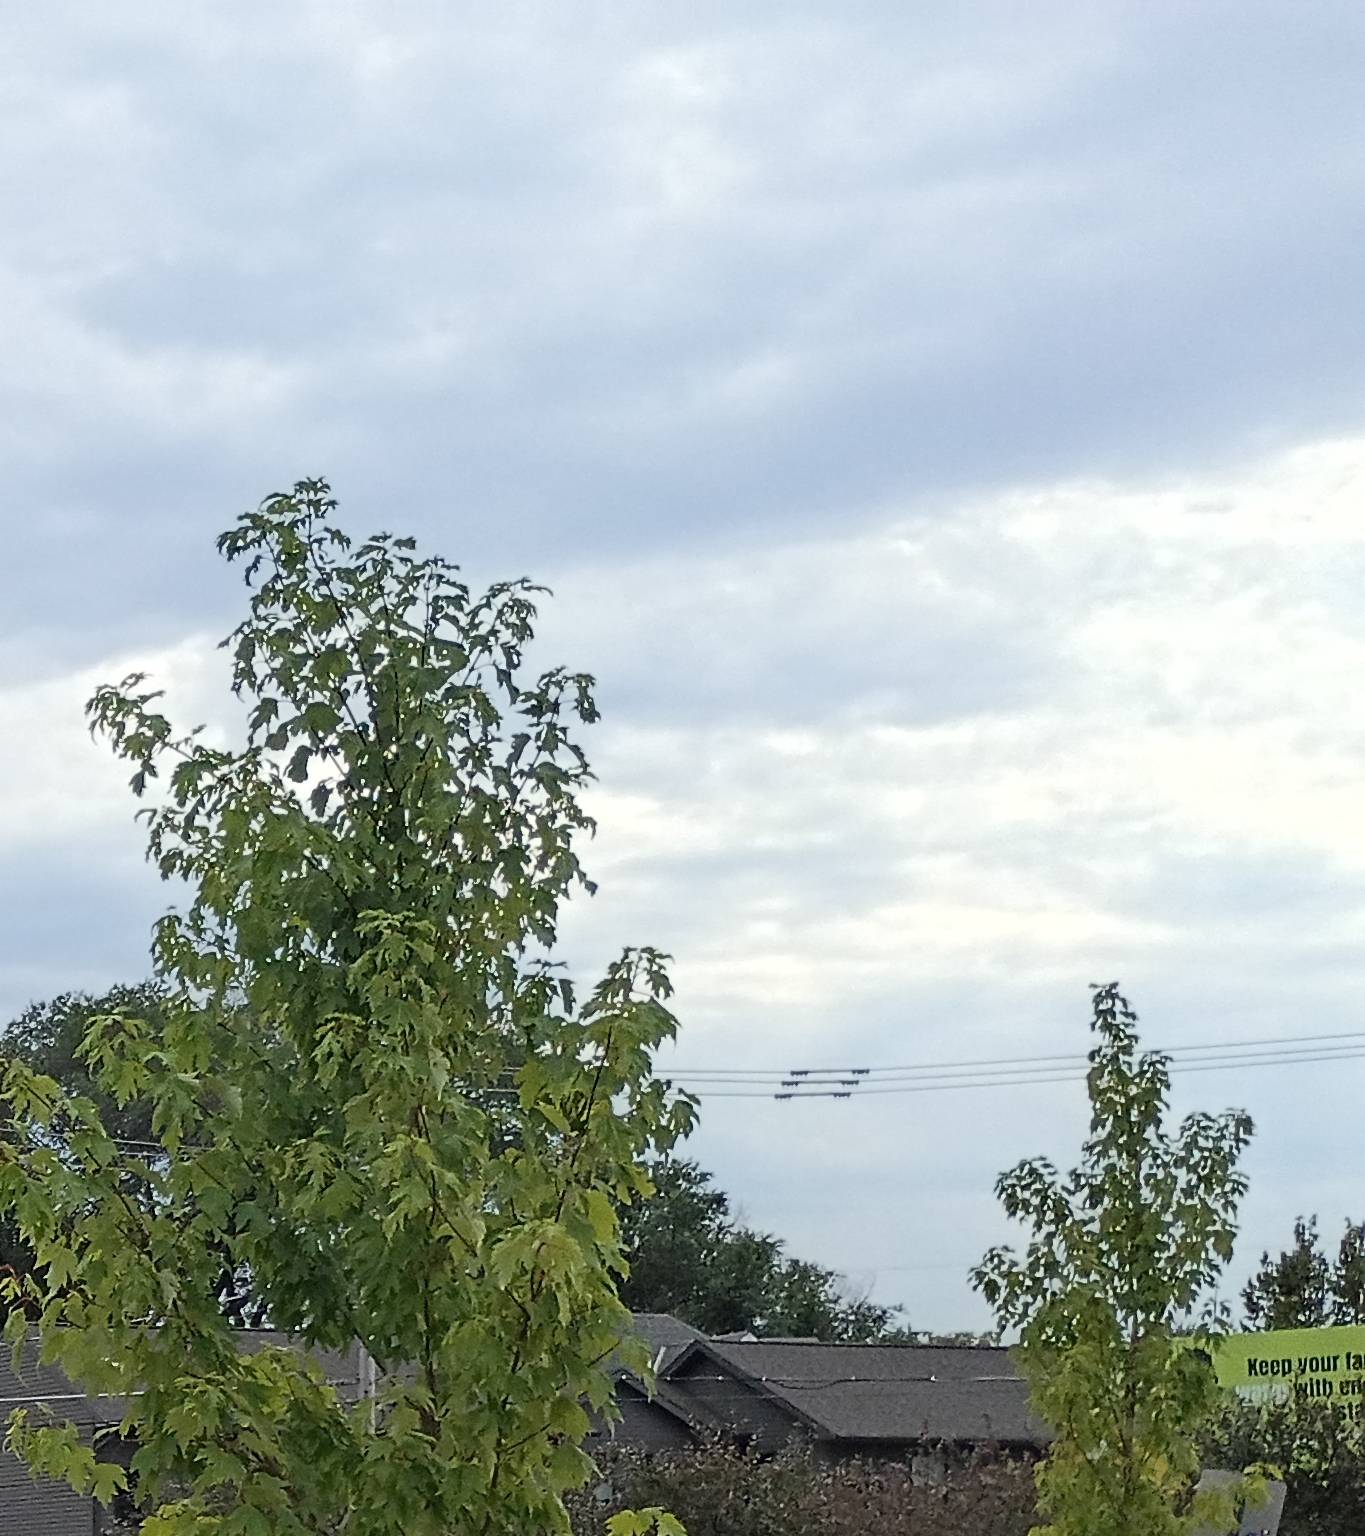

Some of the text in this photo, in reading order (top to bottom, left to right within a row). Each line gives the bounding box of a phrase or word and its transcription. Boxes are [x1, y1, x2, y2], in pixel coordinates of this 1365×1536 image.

[1248, 1352, 1365, 1377] Keep your fa
